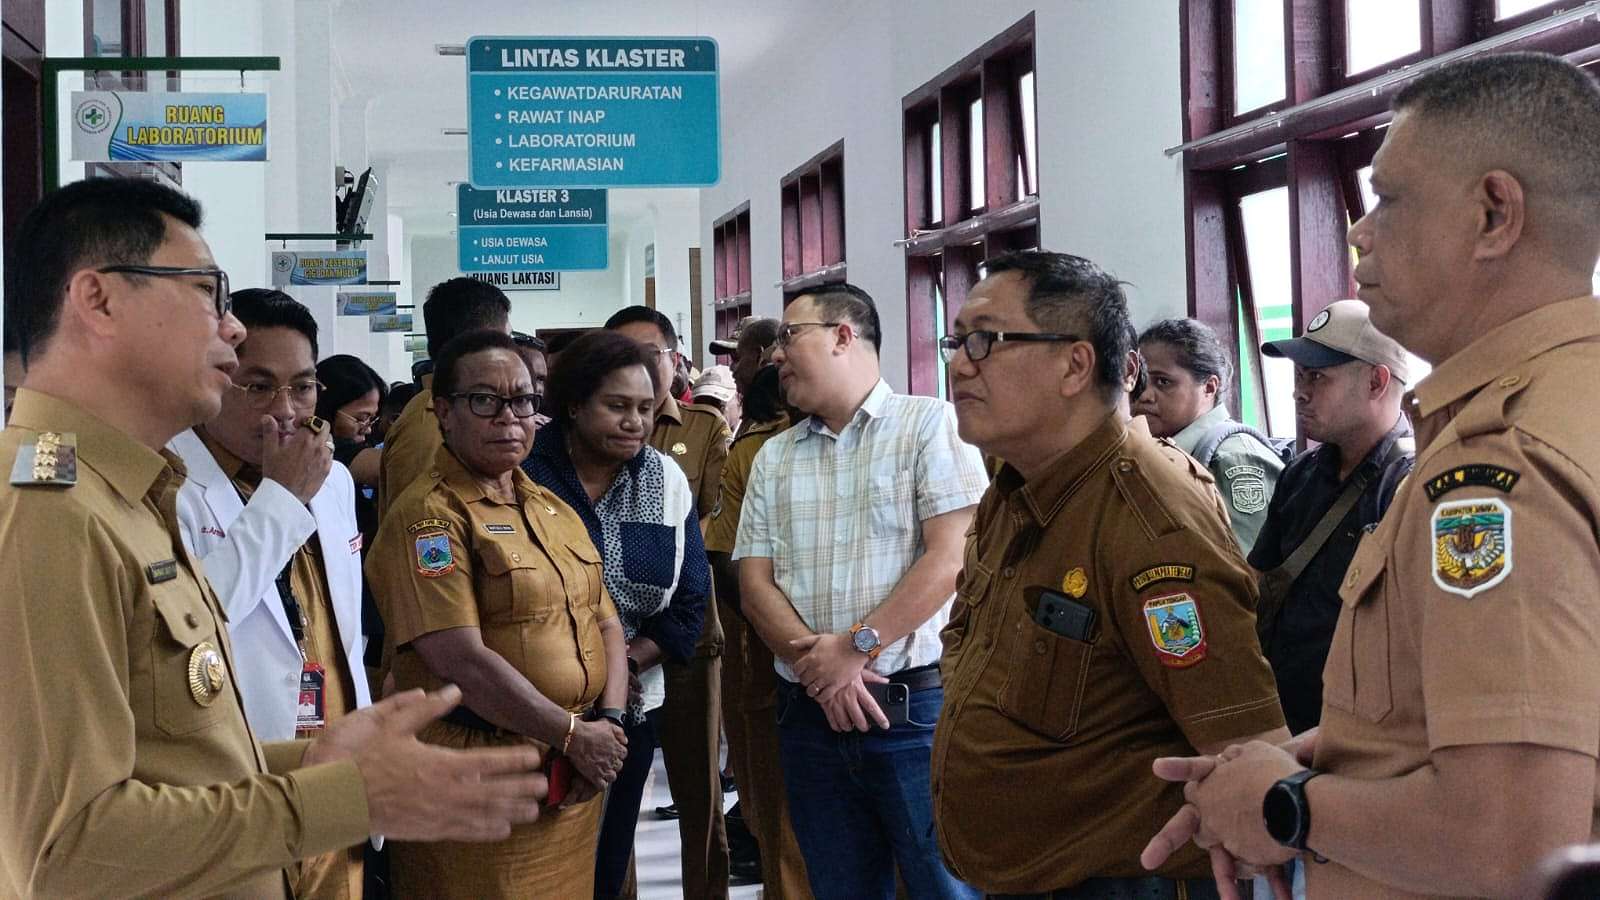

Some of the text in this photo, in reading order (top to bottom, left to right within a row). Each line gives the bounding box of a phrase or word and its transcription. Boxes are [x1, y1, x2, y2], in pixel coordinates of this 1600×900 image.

[501, 48, 685, 68] LINTAS KLASTER
[507, 86, 682, 100] KEGAWATDARURATAN
[165, 105, 224, 124] RUANG
[508, 110, 605, 124] RAWAT INAP
[127, 126, 264, 146] LABORATORIUM
[508, 134, 636, 148] LABORATORIUM
[509, 158, 624, 171] KEFARMASIAN
[496, 189, 569, 203] KLASTER 3
[473, 207, 593, 221] (Usia Dewasa dan Lansia)
[481, 237, 548, 247] USIA DEWASA
[481, 254, 544, 265] LANJUT USIA
[472, 272, 555, 285] RUANG LAKTASI
